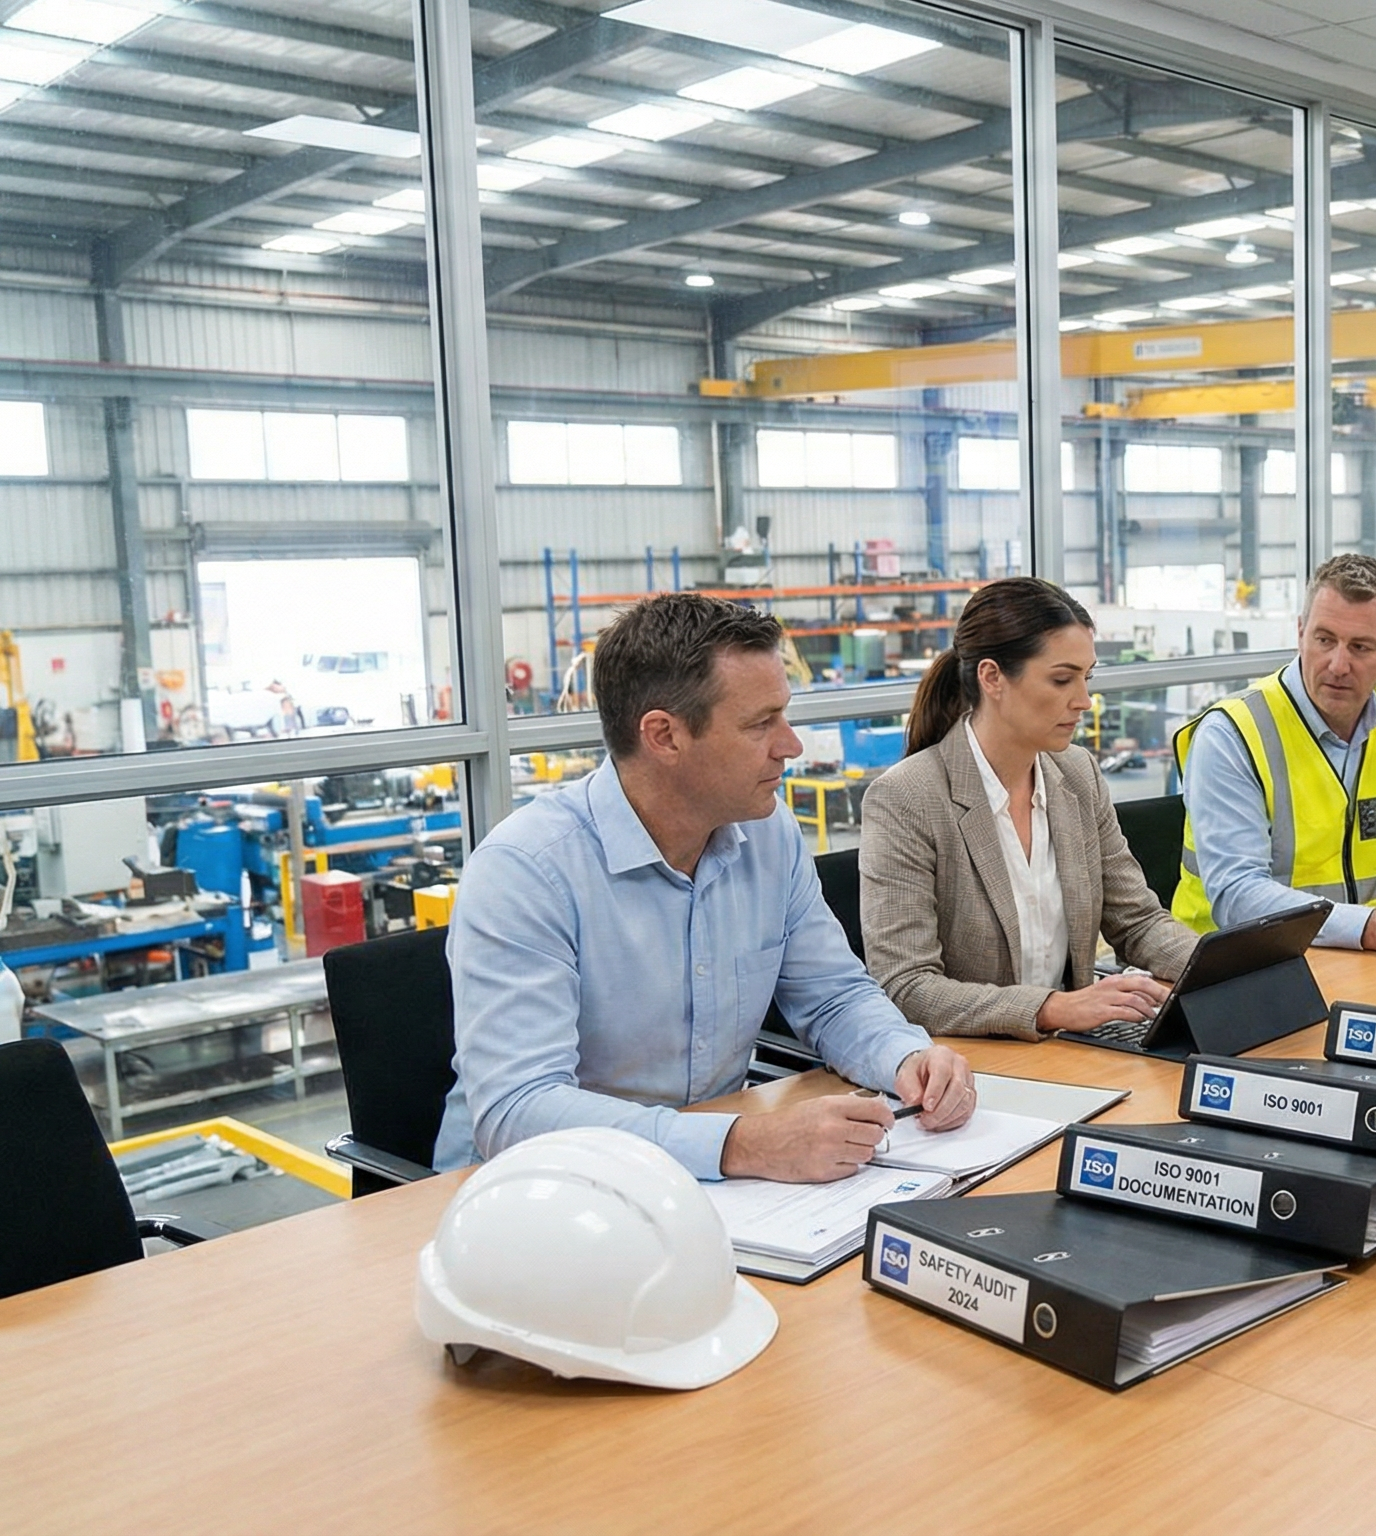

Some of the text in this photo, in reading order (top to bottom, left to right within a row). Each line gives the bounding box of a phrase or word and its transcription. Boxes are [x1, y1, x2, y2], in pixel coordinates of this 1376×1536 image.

[1347, 1028, 1374, 1043] ISO
[1202, 1083, 1231, 1099] ISO
[1263, 1093, 1323, 1117] ISO 9001
[1083, 1158, 1115, 1176] ISO
[1154, 1160, 1220, 1187] ISO 9001
[1118, 1176, 1255, 1217] DOCUMENTATION
[883, 1247, 908, 1270] ISO
[918, 1250, 1017, 1302] SAFETY AUDIT
[947, 1287, 979, 1312] 2024
